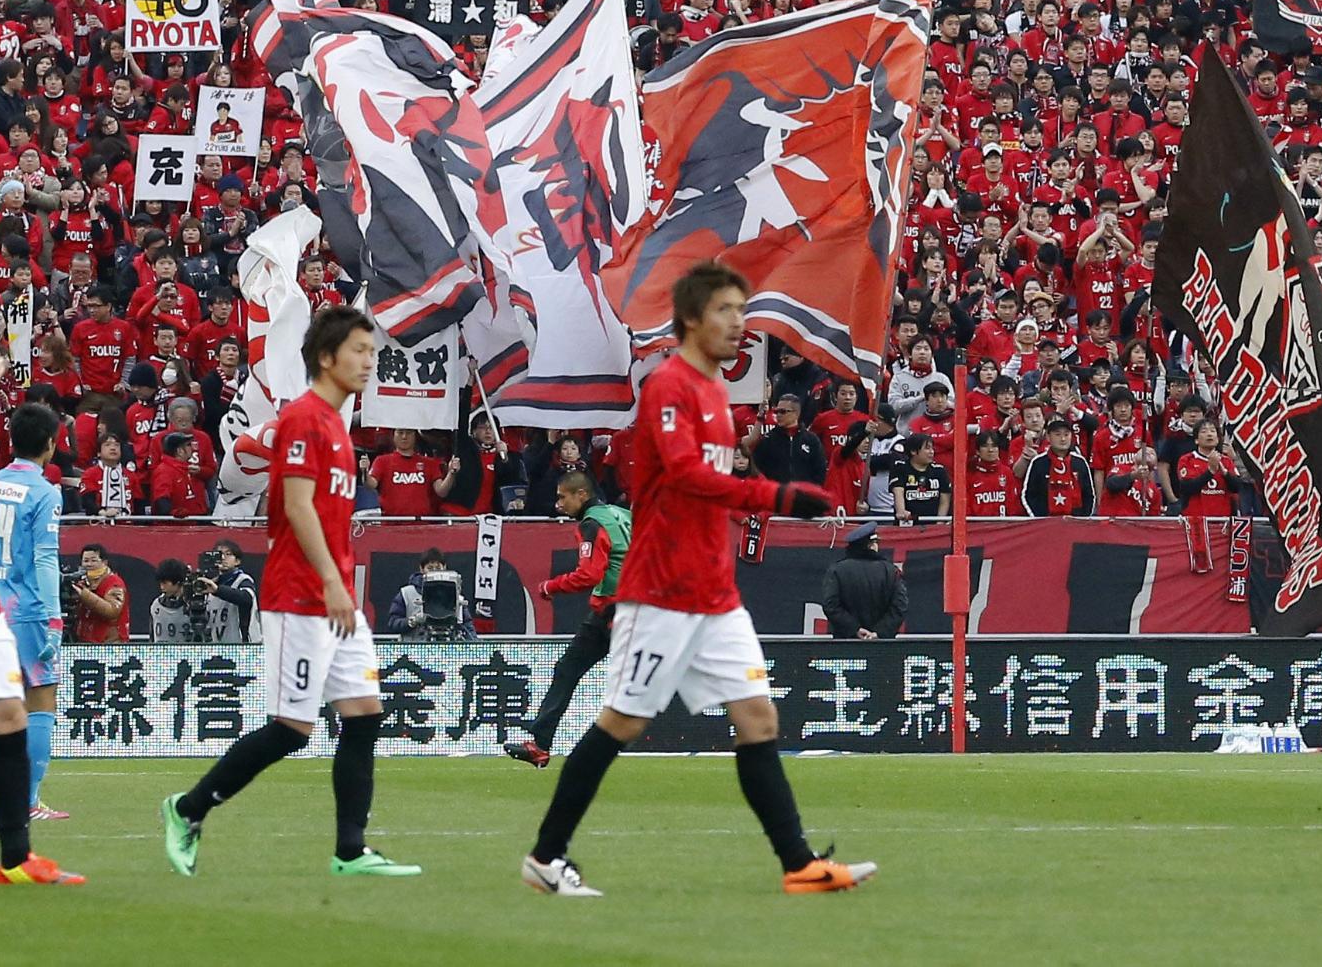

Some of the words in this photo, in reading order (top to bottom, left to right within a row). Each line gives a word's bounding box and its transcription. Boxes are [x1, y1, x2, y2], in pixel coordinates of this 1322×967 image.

[130, 18, 220, 48] RYOTA
[148, 147, 185, 186] 充
[1099, 295, 1114, 309] 22
[88, 344, 121, 357] POLUS
[975, 490, 1006, 505] POLUS
[296, 658, 310, 691] 9
[630, 650, 664, 687] 17
